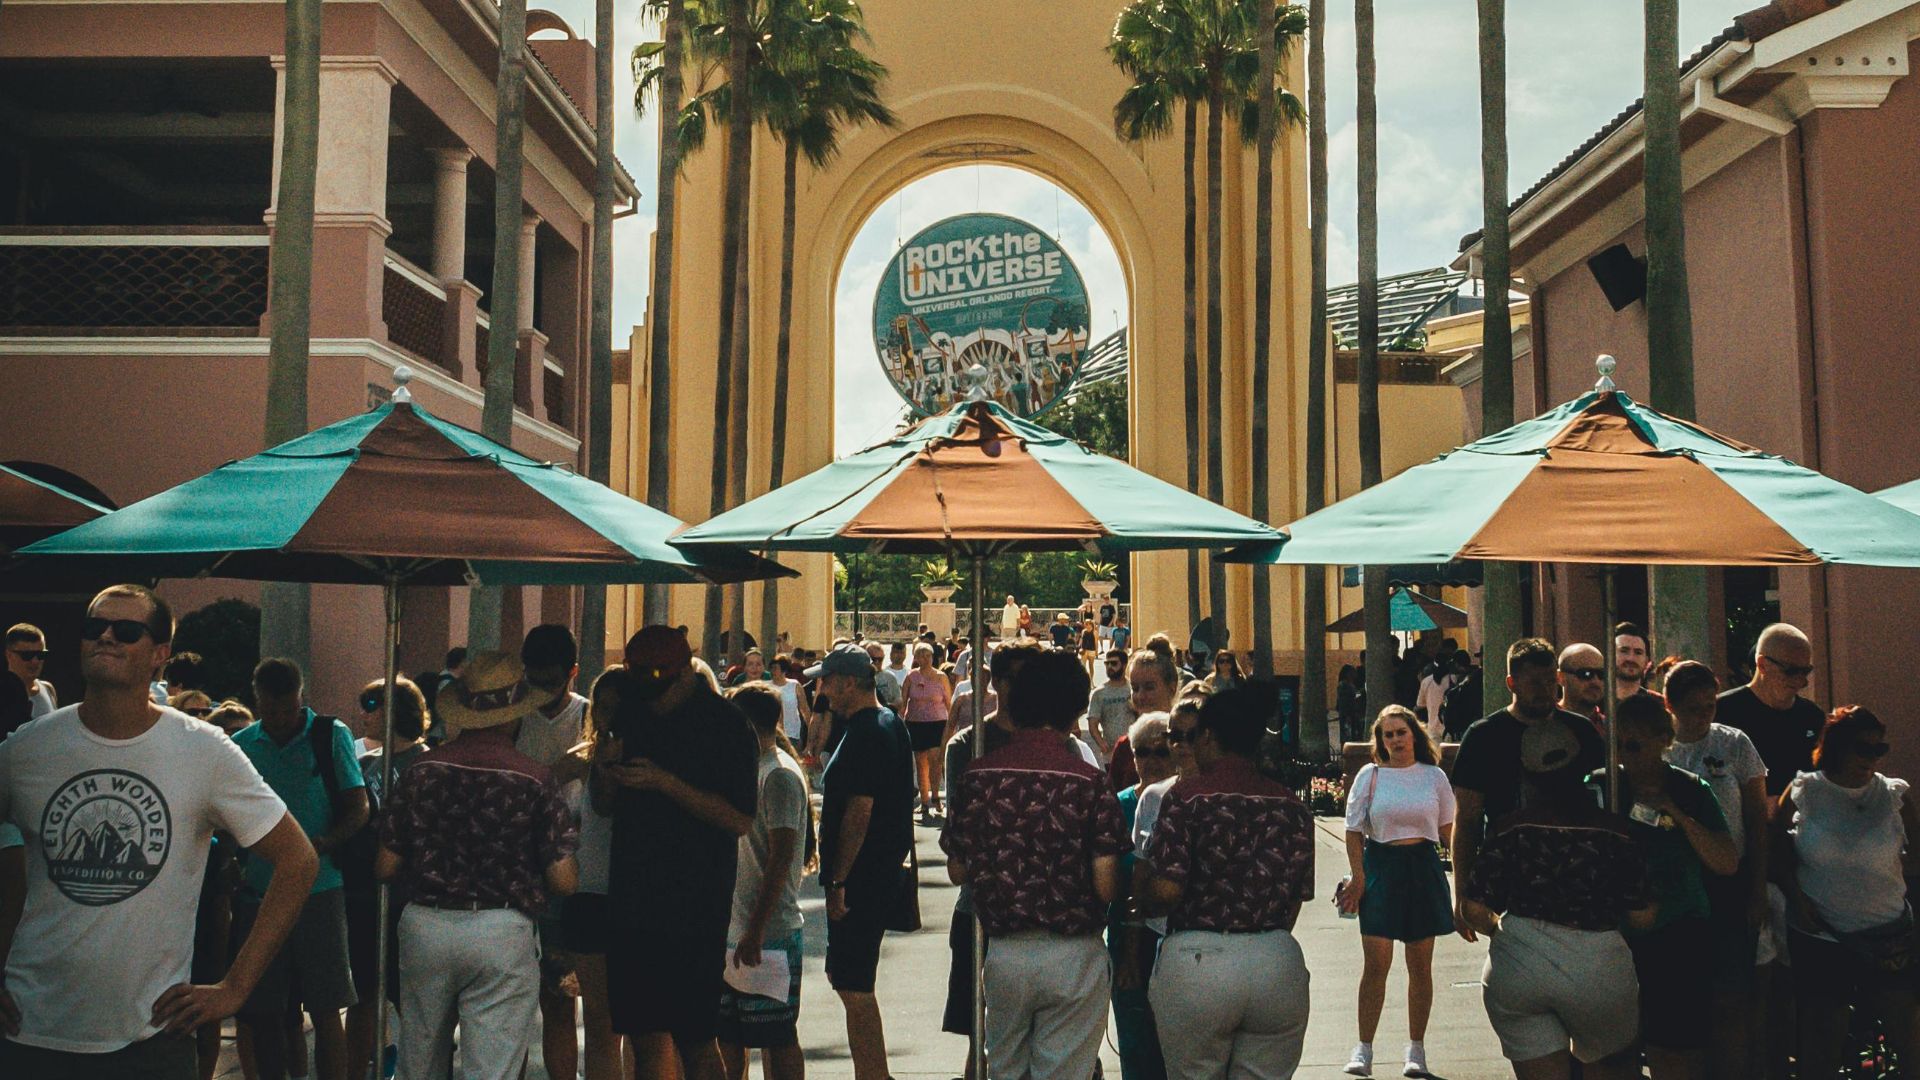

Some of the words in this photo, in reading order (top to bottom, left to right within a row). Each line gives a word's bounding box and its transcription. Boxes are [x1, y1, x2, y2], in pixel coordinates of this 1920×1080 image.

[906, 236, 985, 270] ROCK
[984, 232, 1041, 258] the
[907, 250, 1062, 297] UNIVERSE
[912, 299, 968, 316] UNIVERSAL
[969, 293, 1013, 306] ORLANDO
[1014, 285, 1051, 299] RESORT
[45, 777, 98, 848] EIGHTH
[111, 776, 164, 854] WONDER
